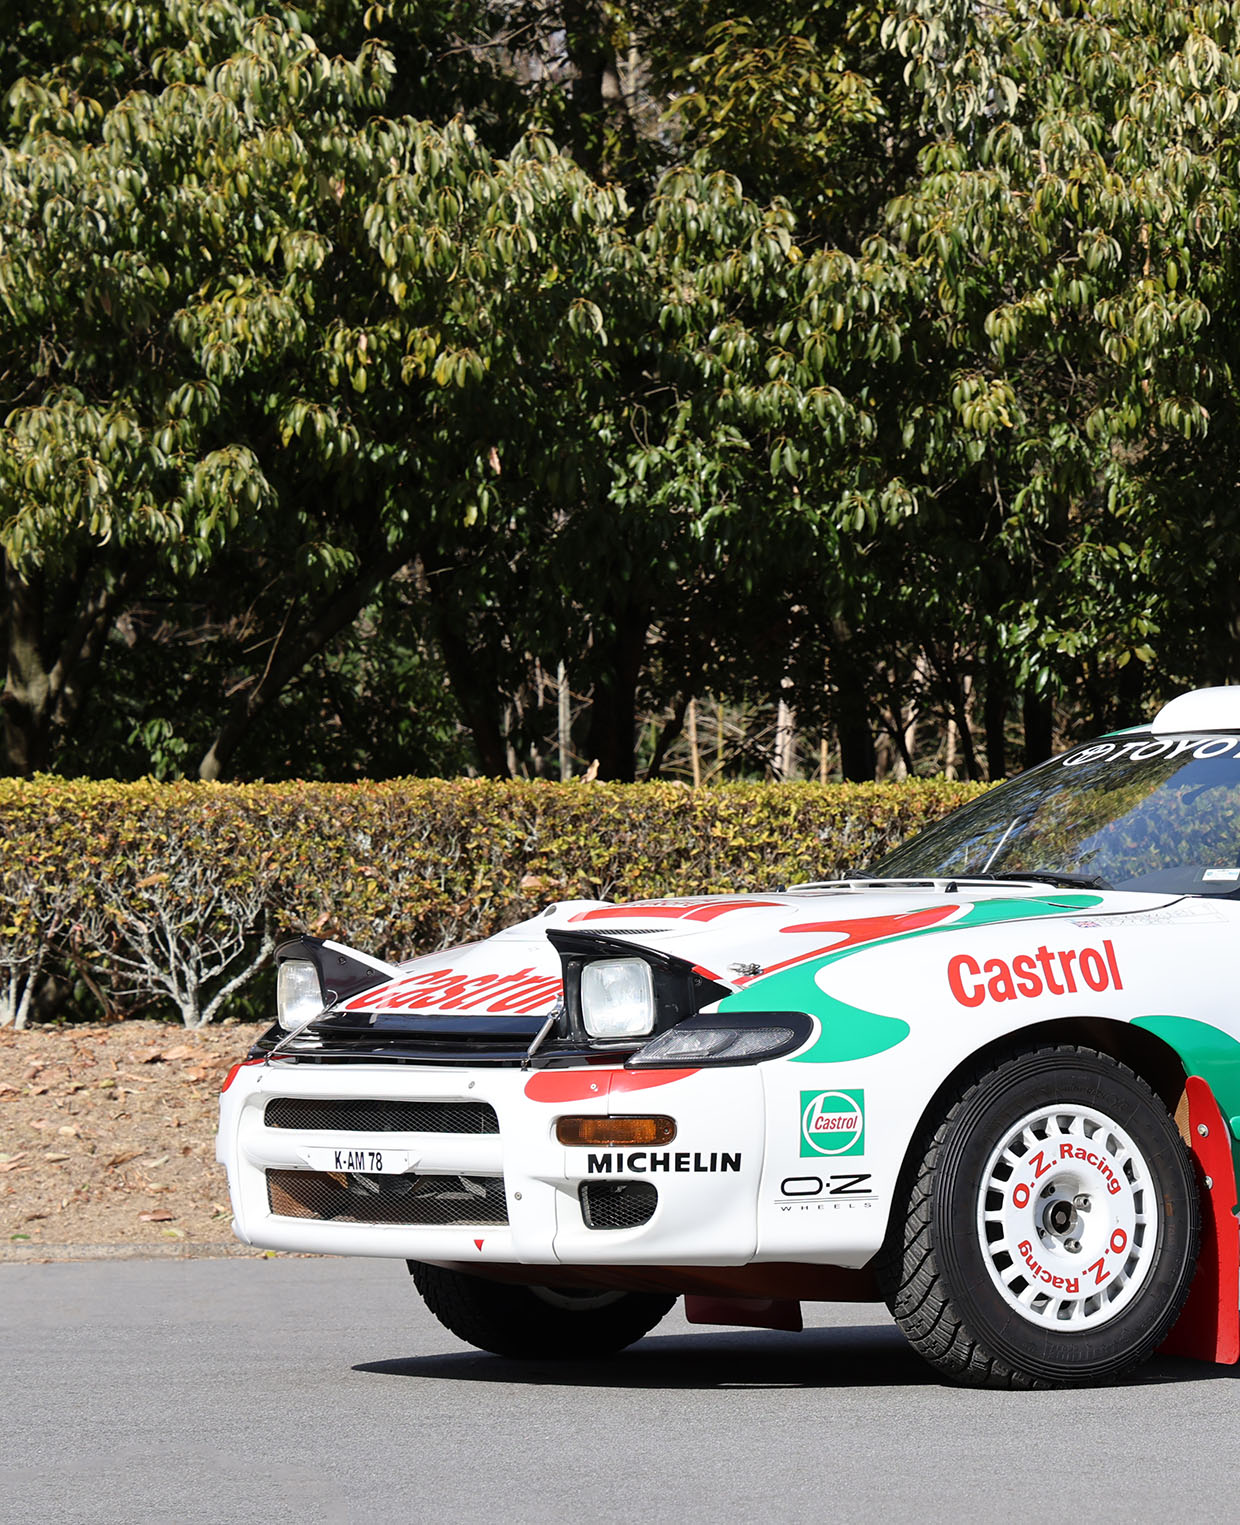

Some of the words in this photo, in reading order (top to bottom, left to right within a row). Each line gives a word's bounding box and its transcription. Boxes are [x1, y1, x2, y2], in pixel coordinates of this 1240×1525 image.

[947, 939, 1124, 1008] Castrol
[814, 1115, 858, 1130] Castrol
[368, 1152, 383, 1171] 78
[586, 1152, 742, 1174] MICHELIN
[1059, 1143, 1122, 1195] Racing
[780, 1202, 873, 1212] WHEELS
[1017, 1239, 1080, 1293] Racing
